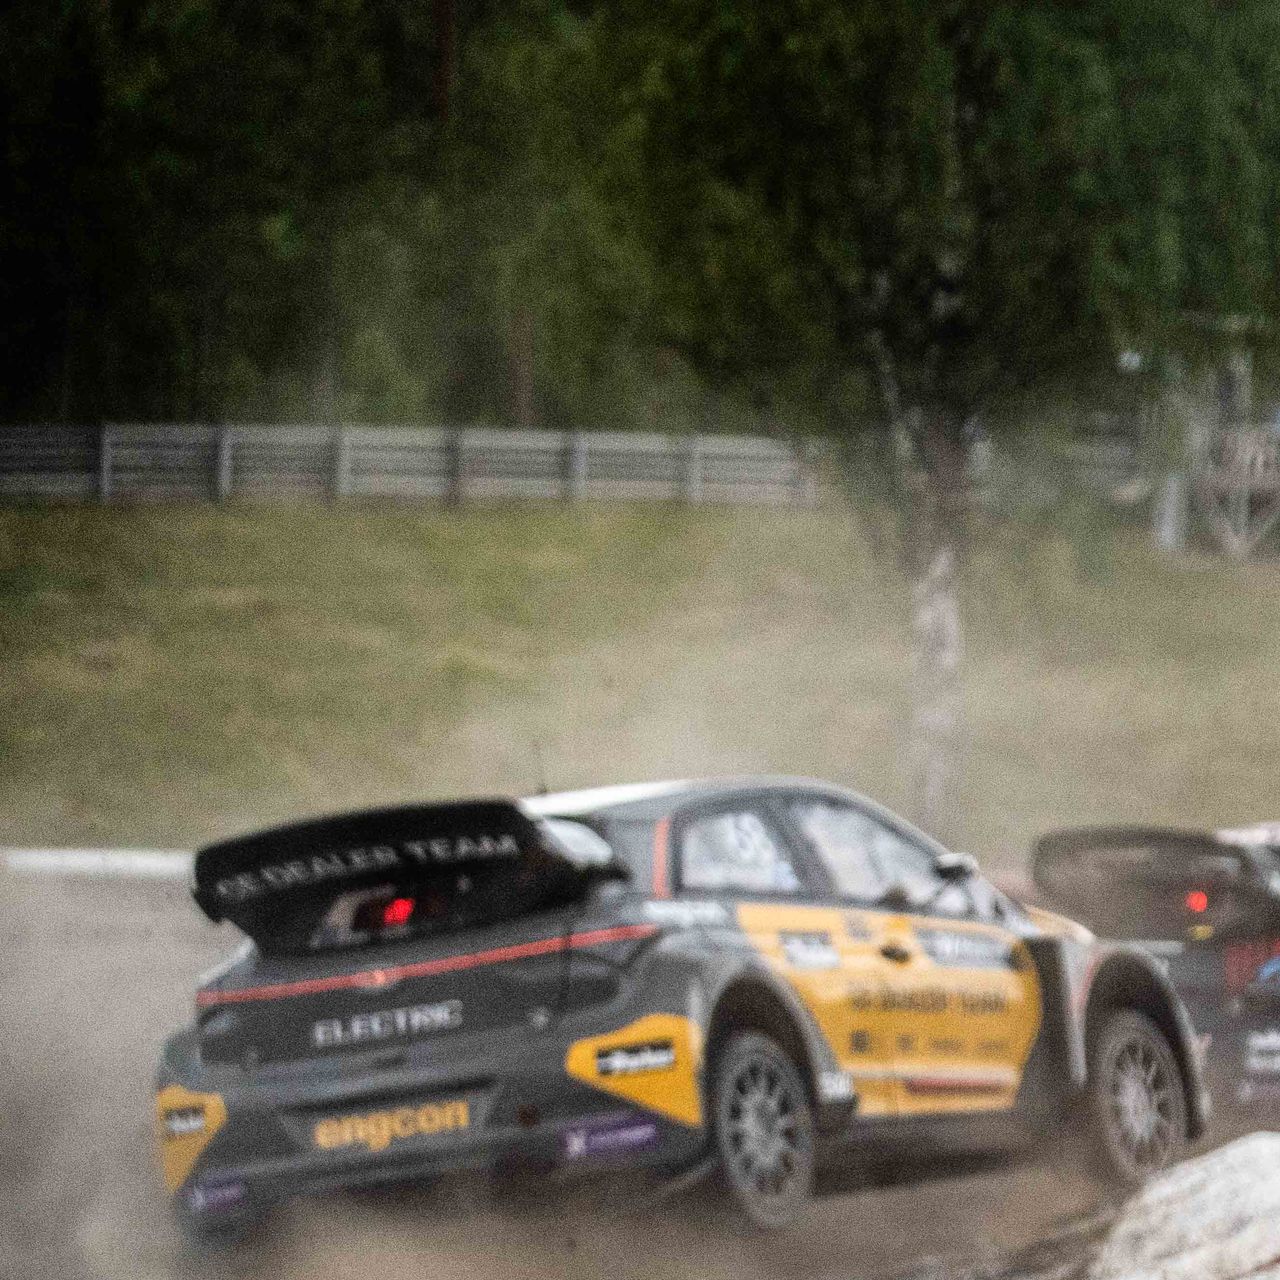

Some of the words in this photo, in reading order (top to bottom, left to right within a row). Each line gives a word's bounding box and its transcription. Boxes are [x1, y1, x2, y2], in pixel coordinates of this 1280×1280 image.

[260, 846, 398, 885] DEALER
[403, 834, 518, 861] TEAM
[312, 999, 464, 1048] ELECTRIC
[314, 1100, 471, 1152] engcon
